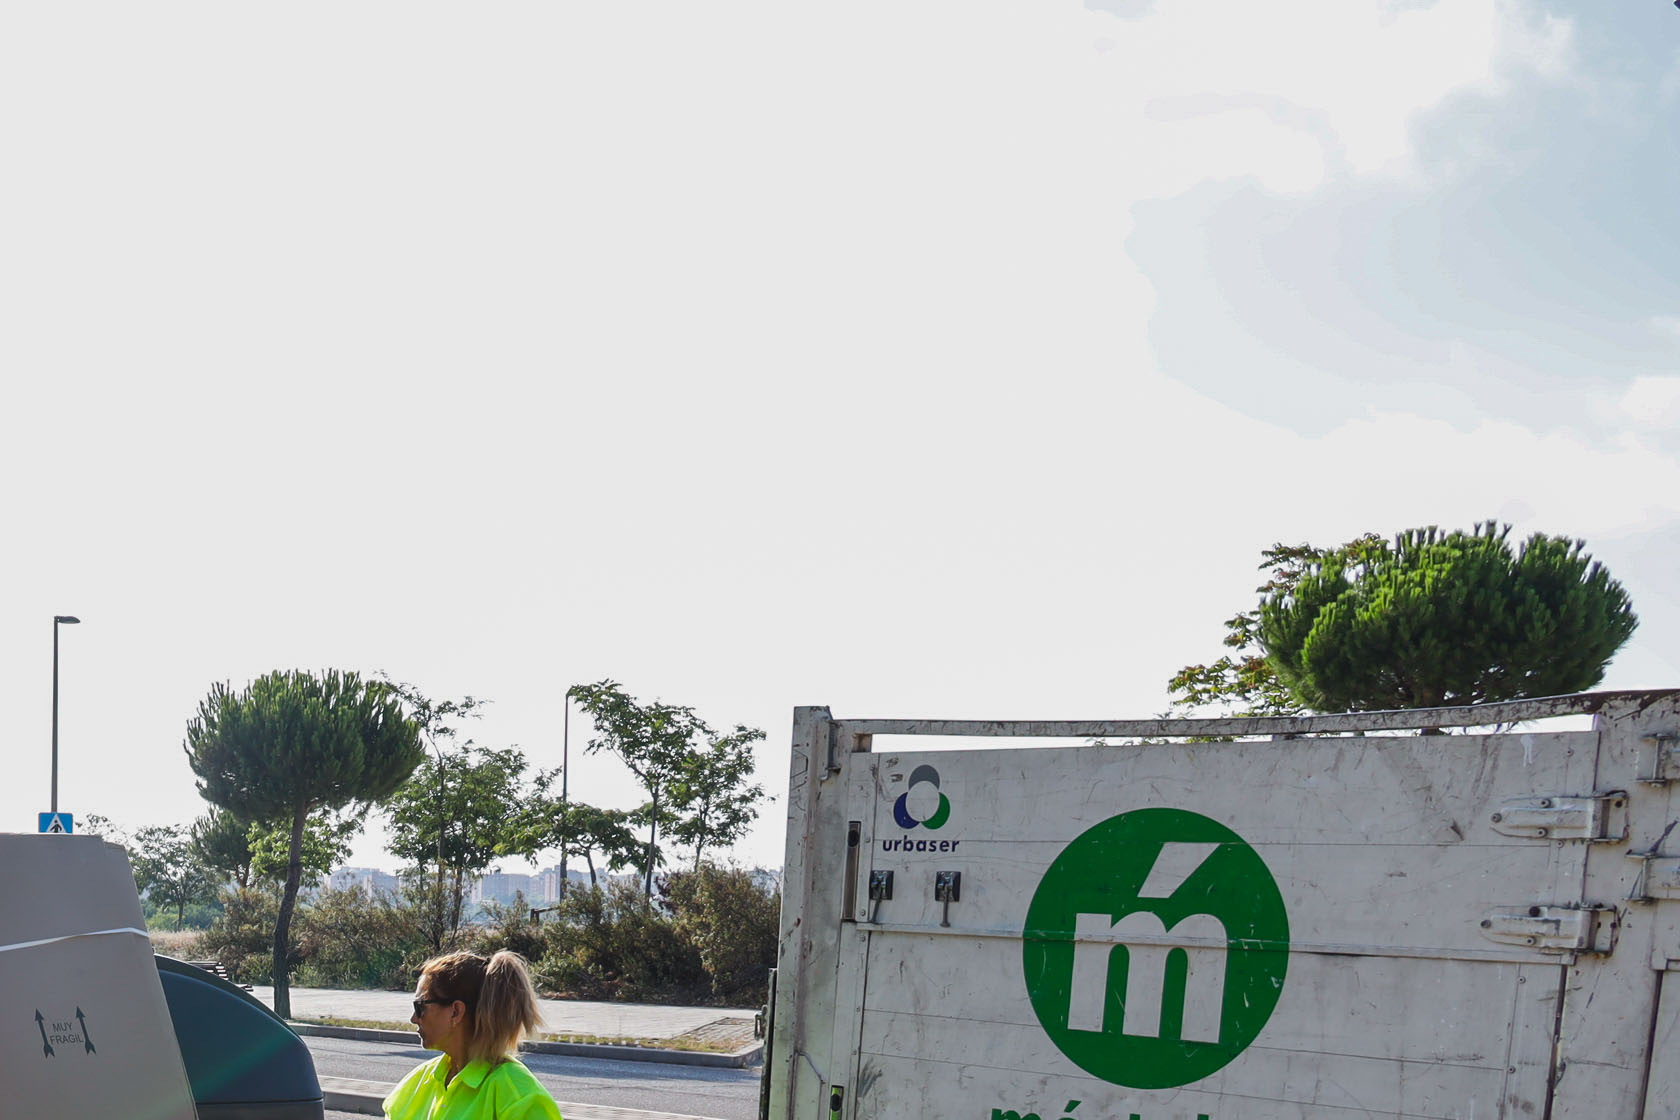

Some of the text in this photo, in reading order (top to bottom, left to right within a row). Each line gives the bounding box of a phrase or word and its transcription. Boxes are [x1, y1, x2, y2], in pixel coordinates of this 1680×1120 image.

[882, 834, 960, 852] urbaser
[52, 1021, 73, 1033] MUY
[49, 1033, 85, 1045] FRAGIL
